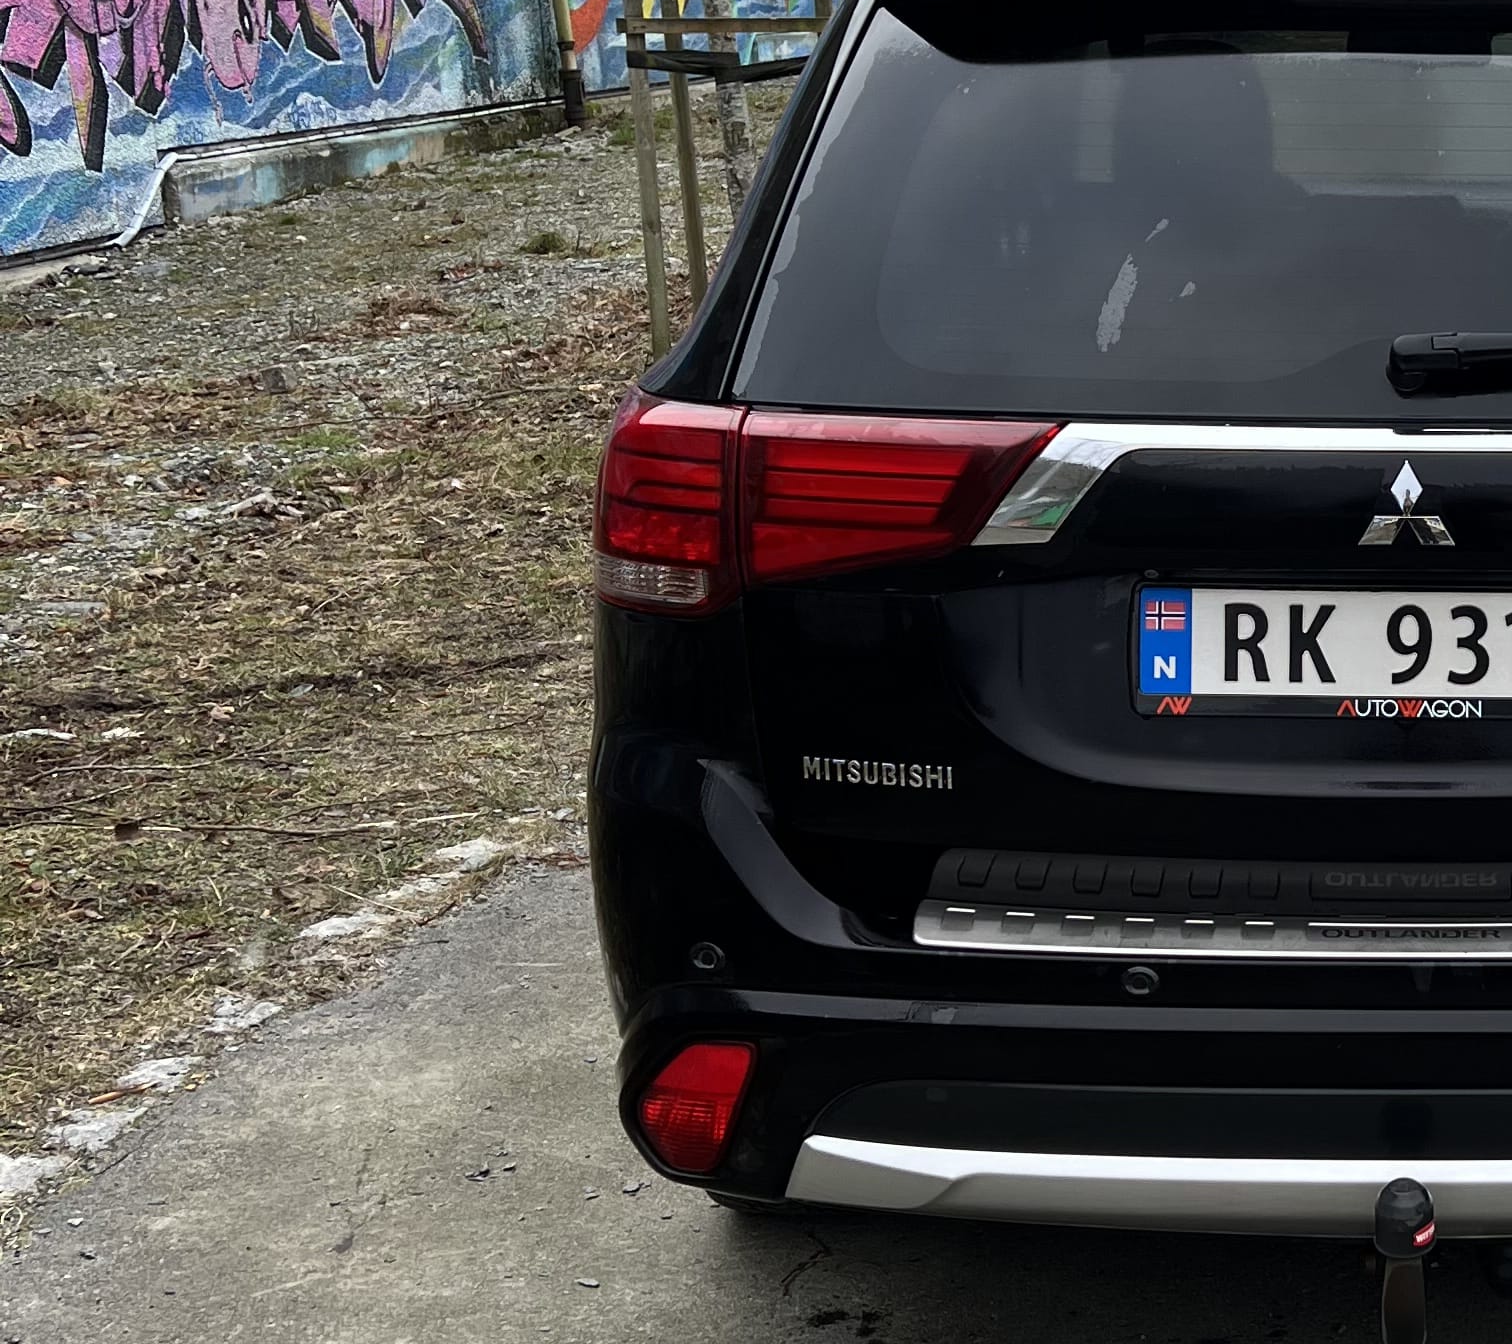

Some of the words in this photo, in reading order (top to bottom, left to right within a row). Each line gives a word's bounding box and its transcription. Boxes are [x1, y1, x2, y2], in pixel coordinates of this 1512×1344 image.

[1223, 603, 1337, 684] RK
[1153, 655, 1176, 679] N
[1336, 699, 1482, 718] AUTOWAGON
[803, 756, 953, 789] MITSUBISHI
[1321, 927, 1500, 939] OUTLANDER
